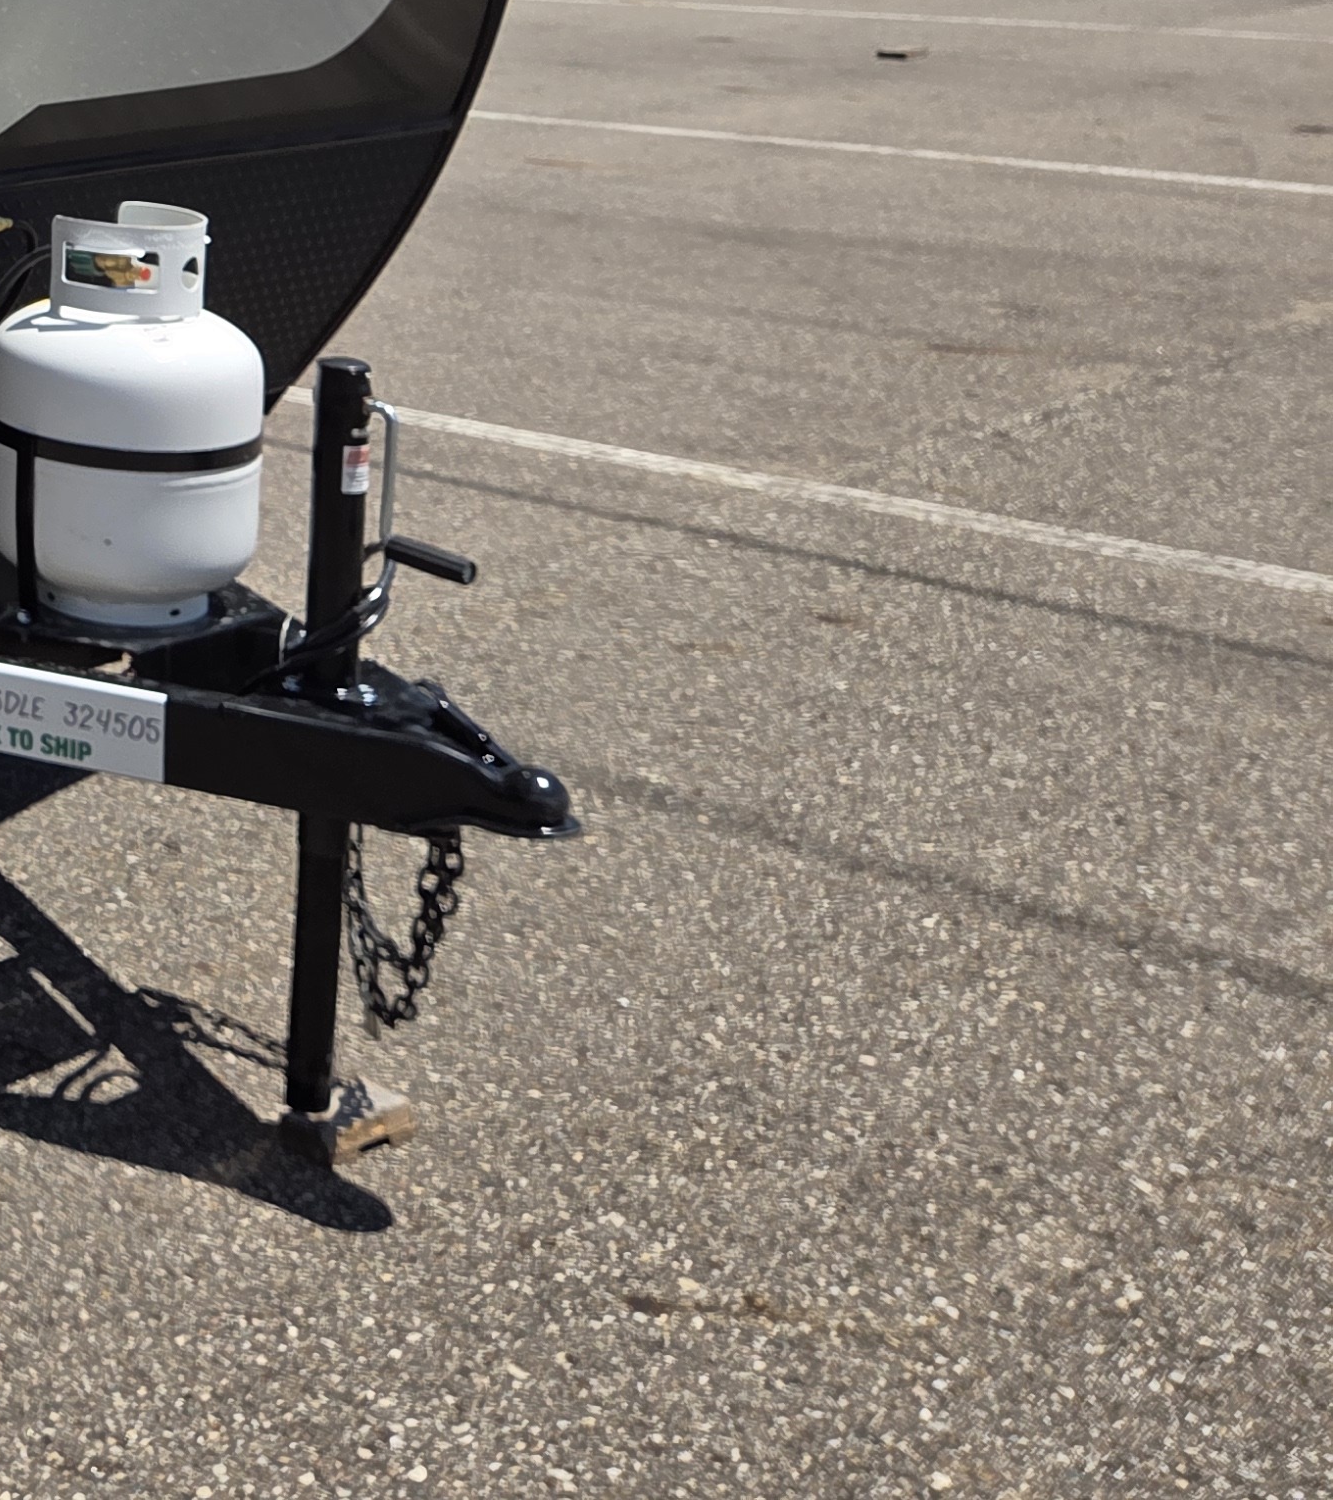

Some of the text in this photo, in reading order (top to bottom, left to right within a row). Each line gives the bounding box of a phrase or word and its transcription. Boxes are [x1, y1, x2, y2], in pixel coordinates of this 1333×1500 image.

[63, 701, 162, 745] 324505
[7, 726, 33, 750] TO
[40, 733, 92, 761] SHIP
